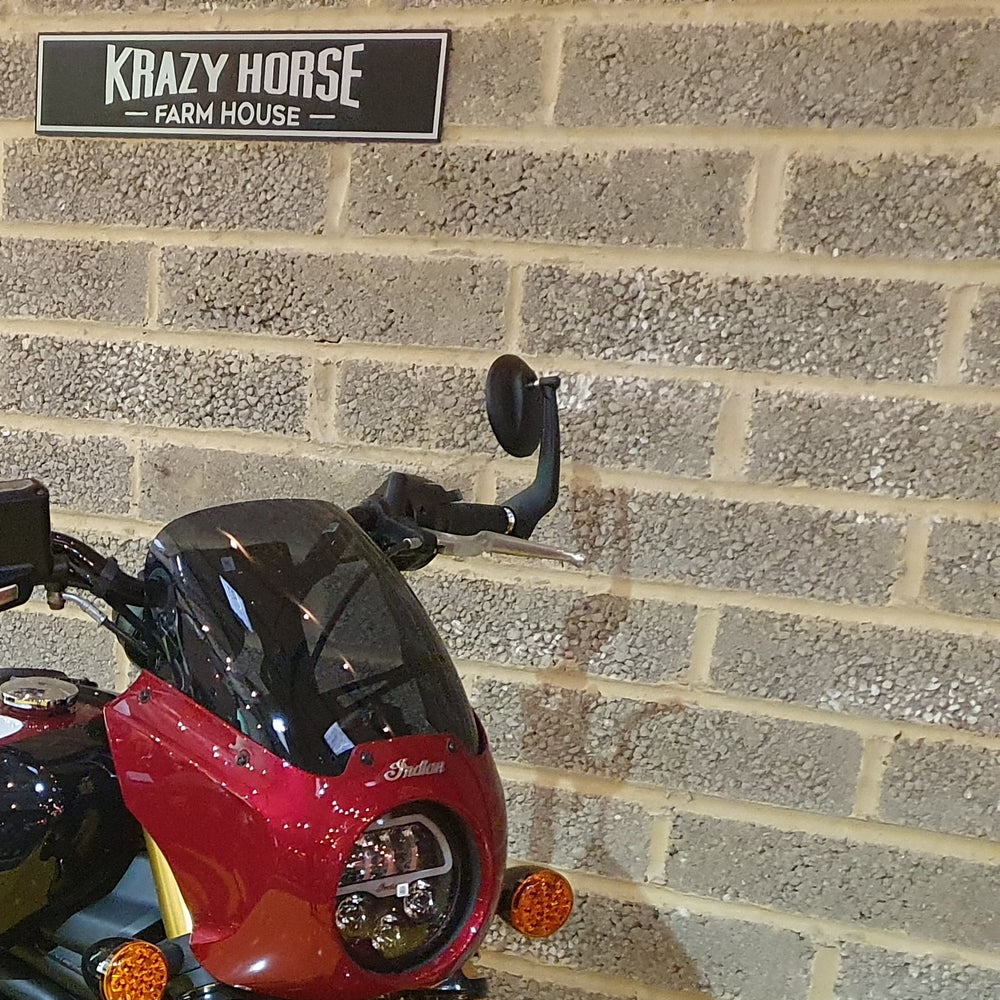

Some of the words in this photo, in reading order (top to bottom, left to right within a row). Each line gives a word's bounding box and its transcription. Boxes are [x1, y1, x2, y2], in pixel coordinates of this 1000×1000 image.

[104, 43, 229, 106] KRAZY
[236, 42, 366, 109] HORSE
[154, 102, 214, 125] FARM
[219, 101, 301, 127] HOUSE
[383, 757, 446, 782] Indian
